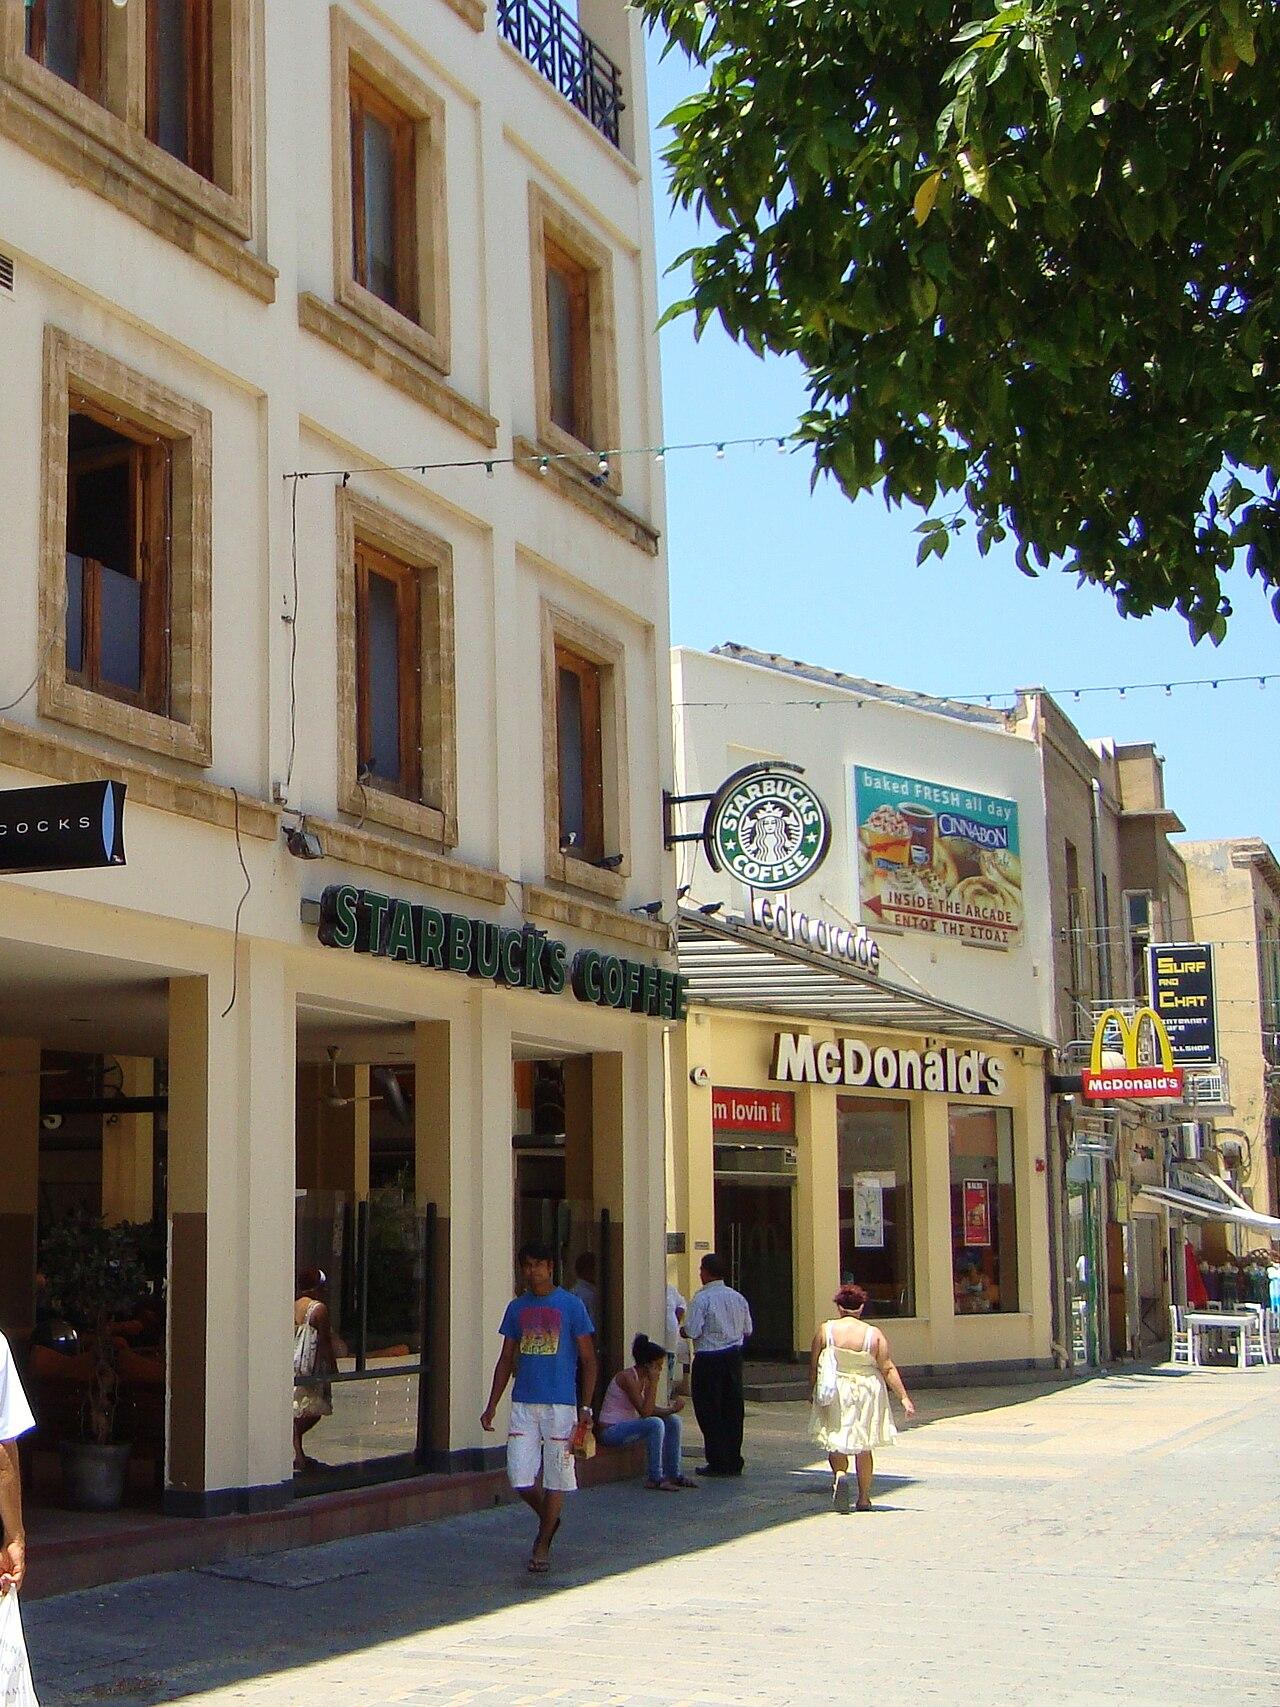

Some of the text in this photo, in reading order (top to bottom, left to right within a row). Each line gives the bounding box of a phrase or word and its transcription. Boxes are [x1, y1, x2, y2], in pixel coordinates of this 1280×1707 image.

[722, 780, 819, 832] STARBUCKS
[863, 772, 1012, 819] baked FRESH all day
[938, 813, 1008, 847] CINNABON
[732, 850, 809, 881] COFFEE
[888, 891, 1013, 924] INSIDE THE ARCADE
[328, 883, 688, 1020] STARBUCKS COFFEE
[773, 1032, 1006, 1096] McDonald's
[1087, 1076, 1179, 1091] McDonald's
[771, 1101, 782, 1122] it
